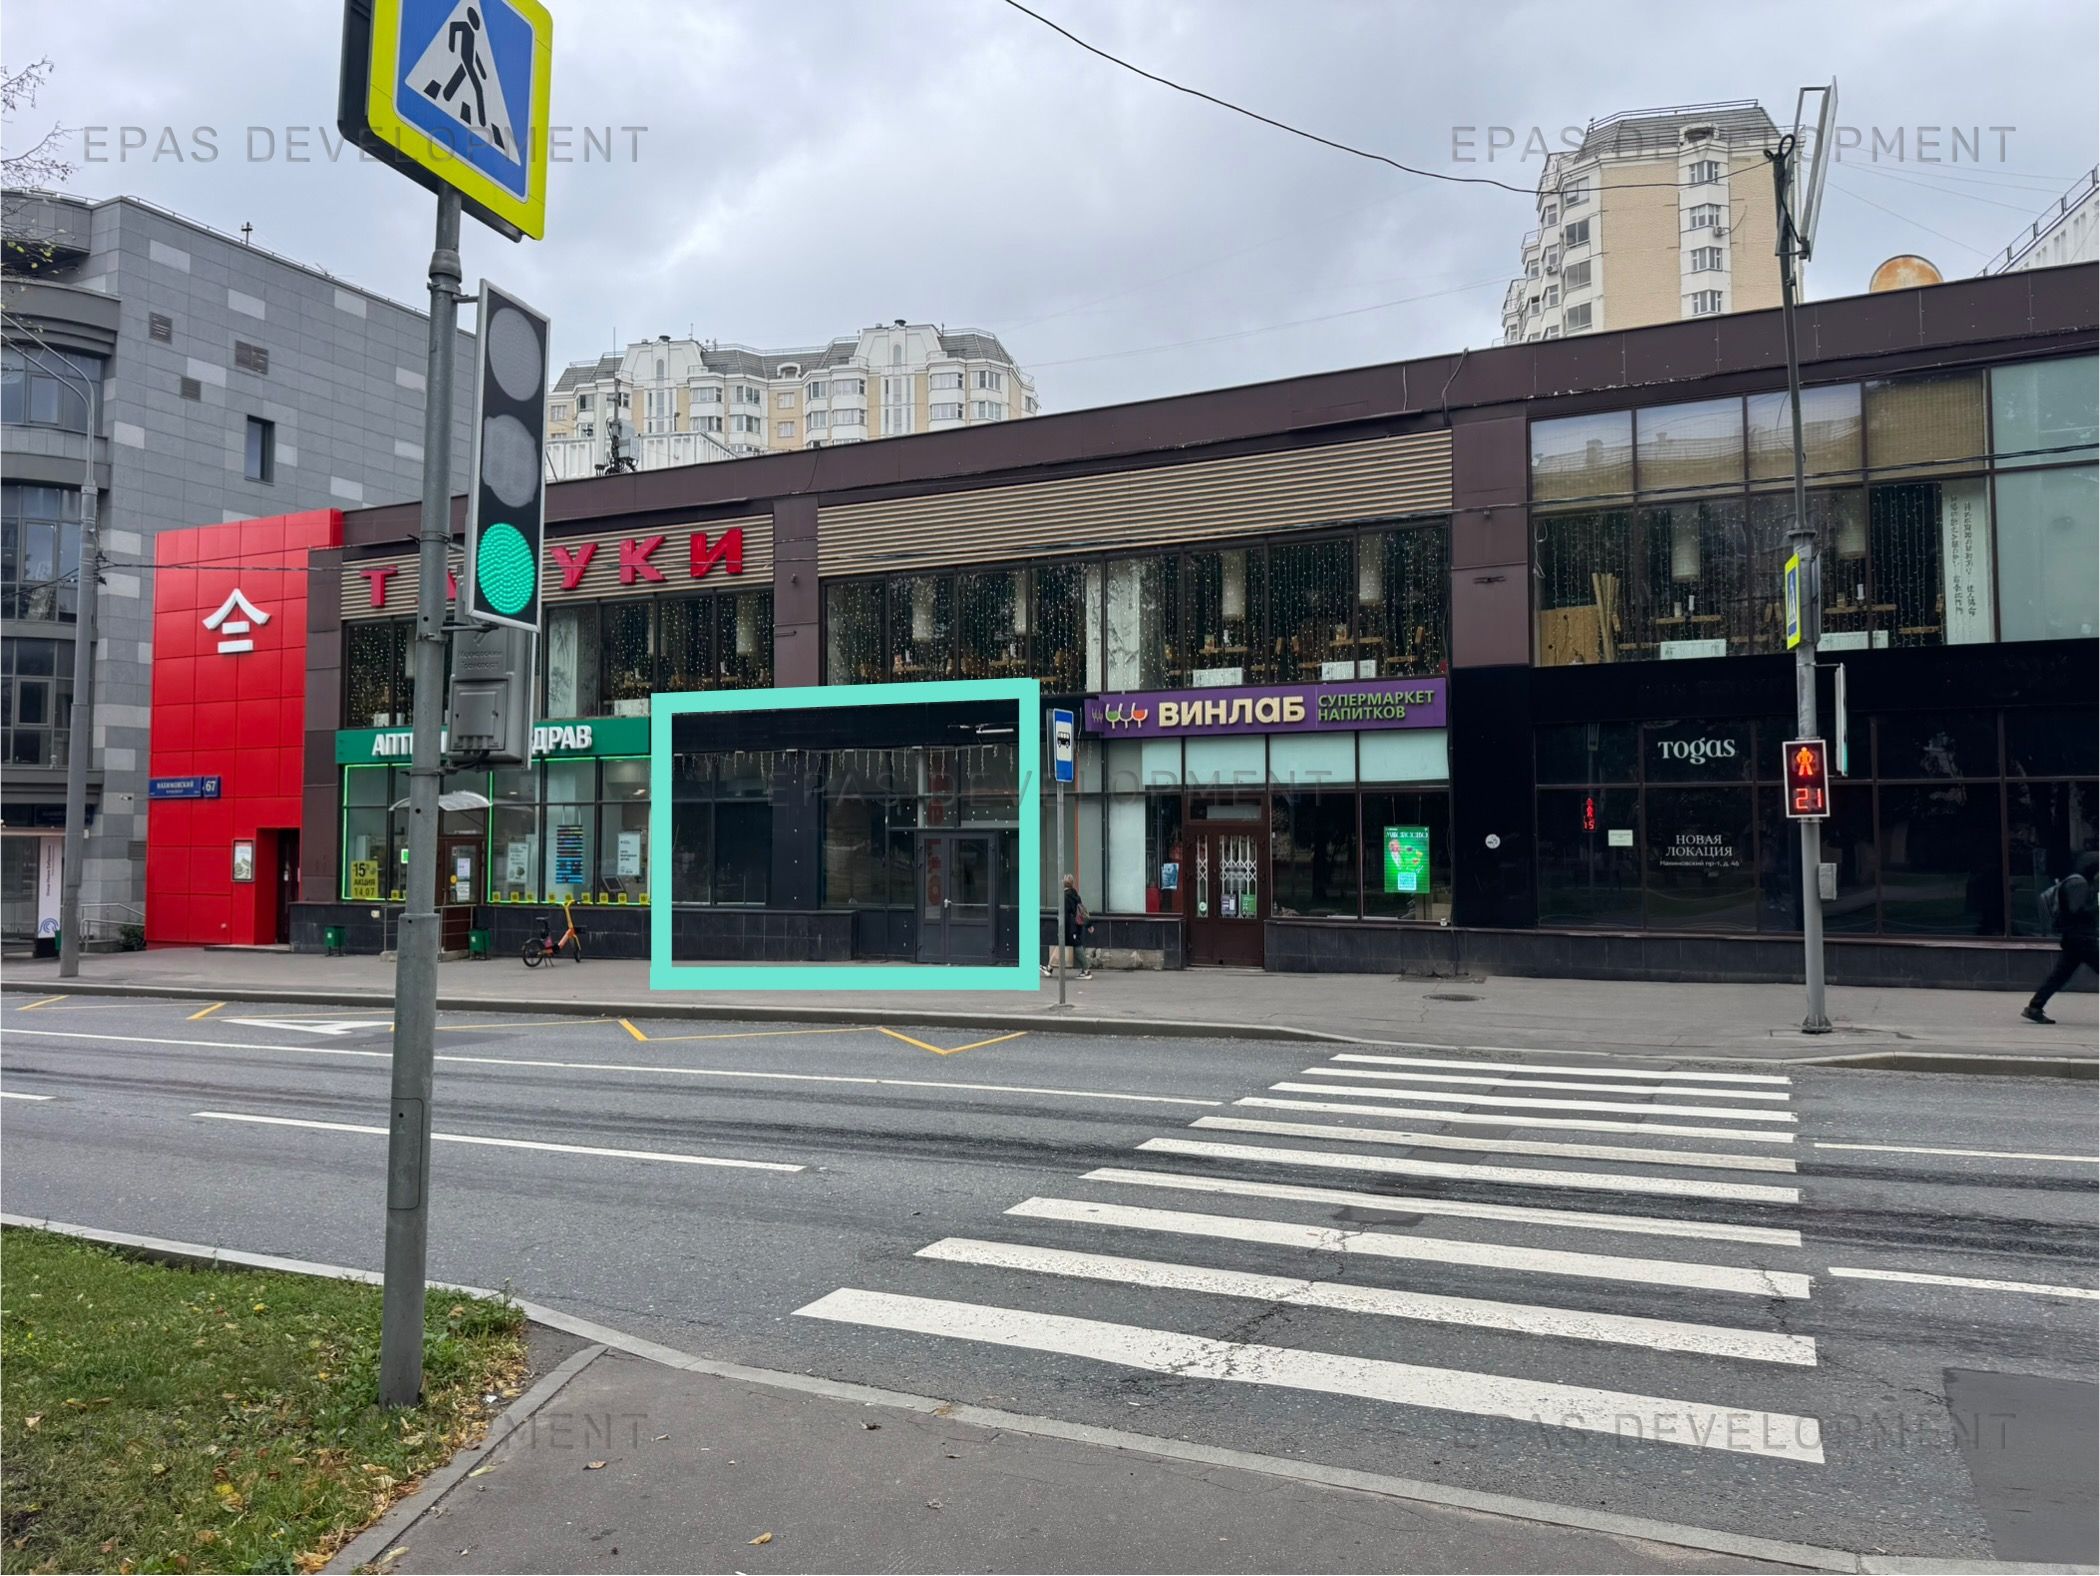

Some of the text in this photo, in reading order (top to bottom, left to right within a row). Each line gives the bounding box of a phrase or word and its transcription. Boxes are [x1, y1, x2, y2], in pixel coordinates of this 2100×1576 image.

[360, 528, 743, 608] ТУКИ
[1318, 689, 1435, 708] СУПЕРМАРКЕТ
[1318, 705, 1406, 722] НАПИТКОВ
[205, 781, 216, 792] 67
[1795, 787, 1822, 810] 21
[1675, 834, 1722, 845] НОВАЯ
[1665, 846, 1733, 858] ЛОКАЦИЯ
